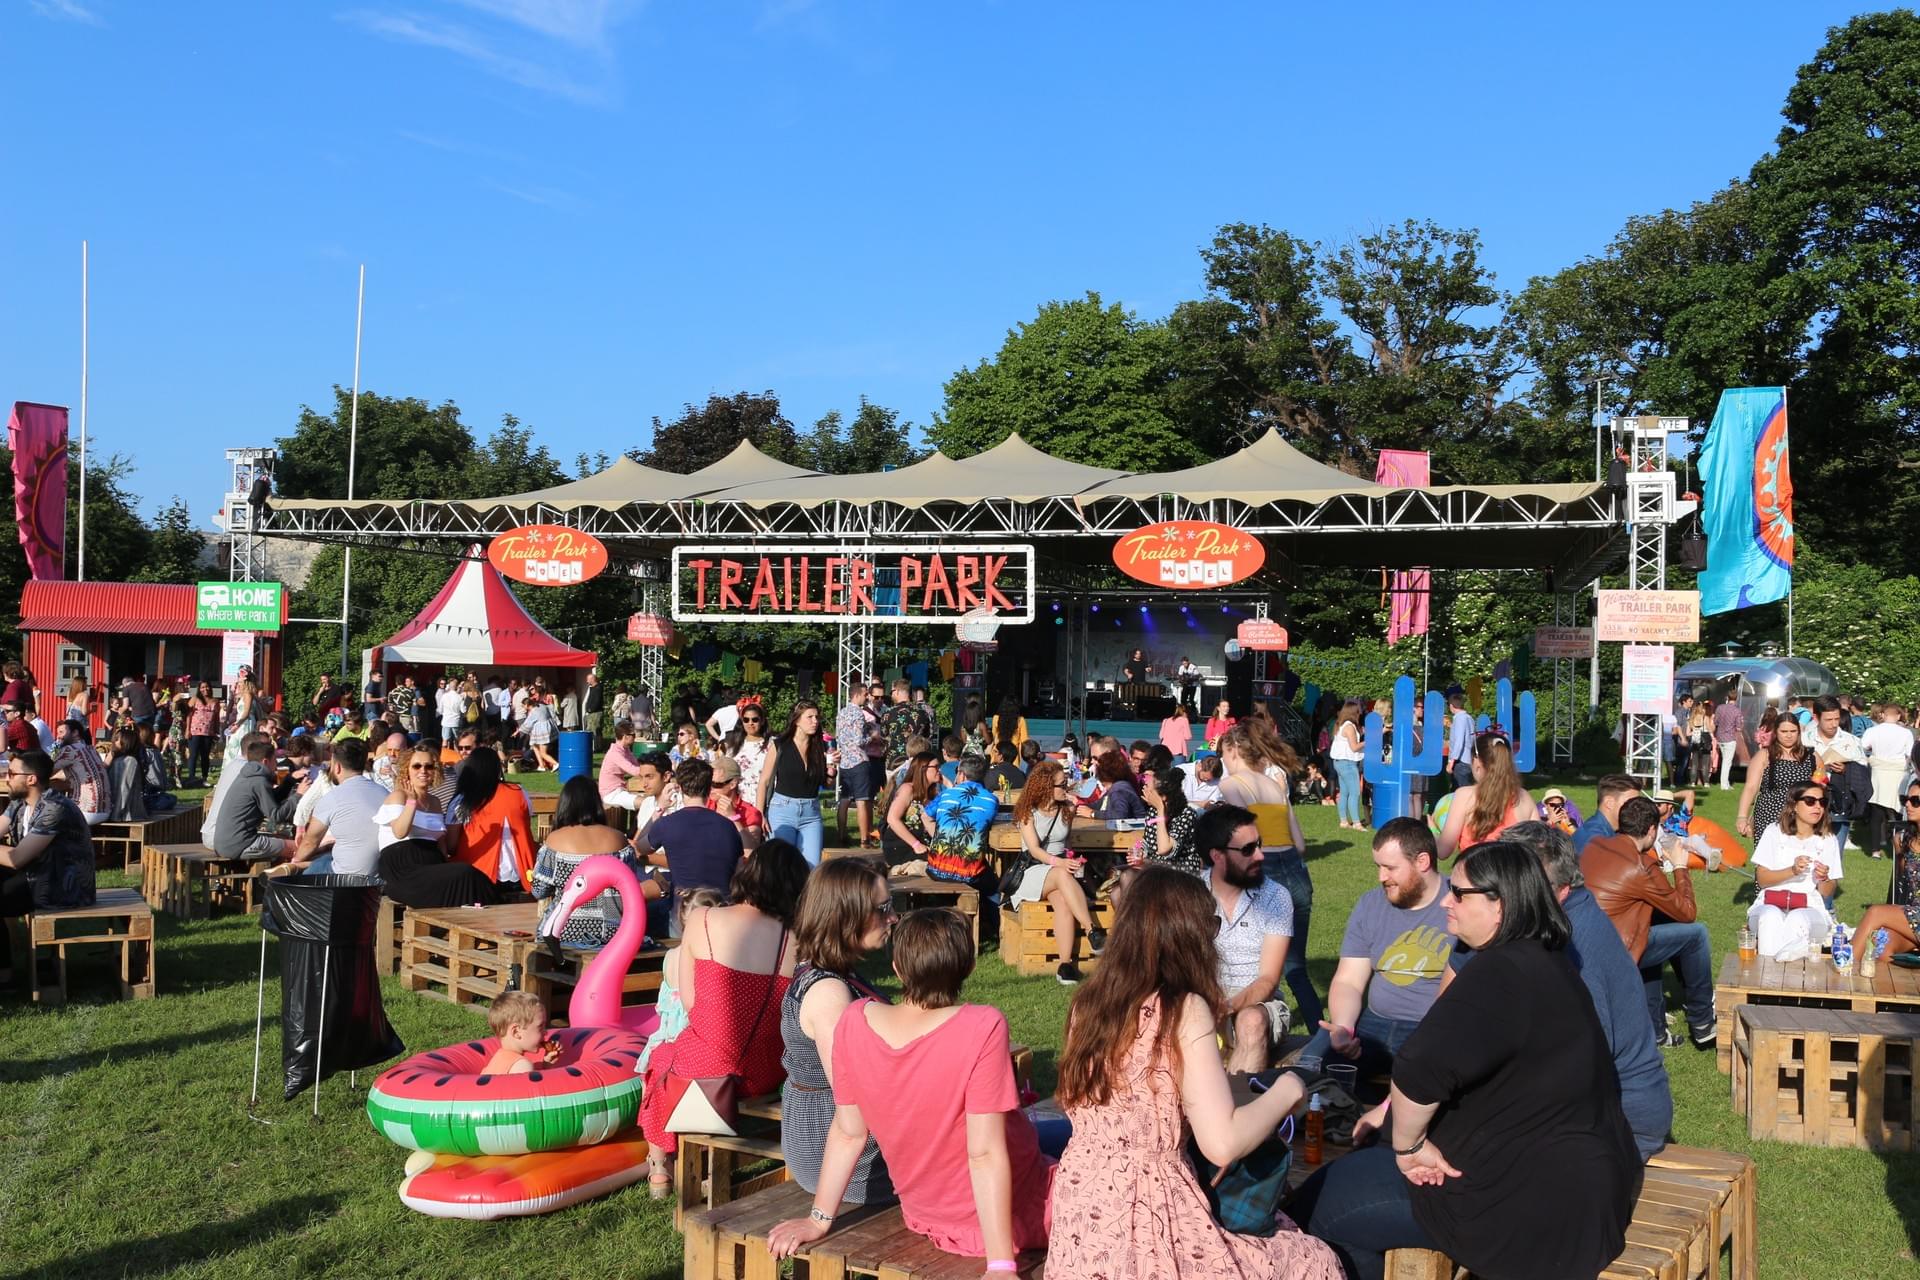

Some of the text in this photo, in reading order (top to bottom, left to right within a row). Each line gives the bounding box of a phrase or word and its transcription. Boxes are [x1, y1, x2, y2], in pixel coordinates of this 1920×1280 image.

[498, 533, 588, 562] Trailer Park
[1126, 528, 1239, 565] Trailer Park
[527, 565, 578, 577] MOTEL
[1162, 565, 1228, 578] MOTEL
[688, 554, 1016, 615] TRAILER PARK
[232, 588, 276, 607] HOME
[1620, 602, 1692, 614] TRAILER PARK
